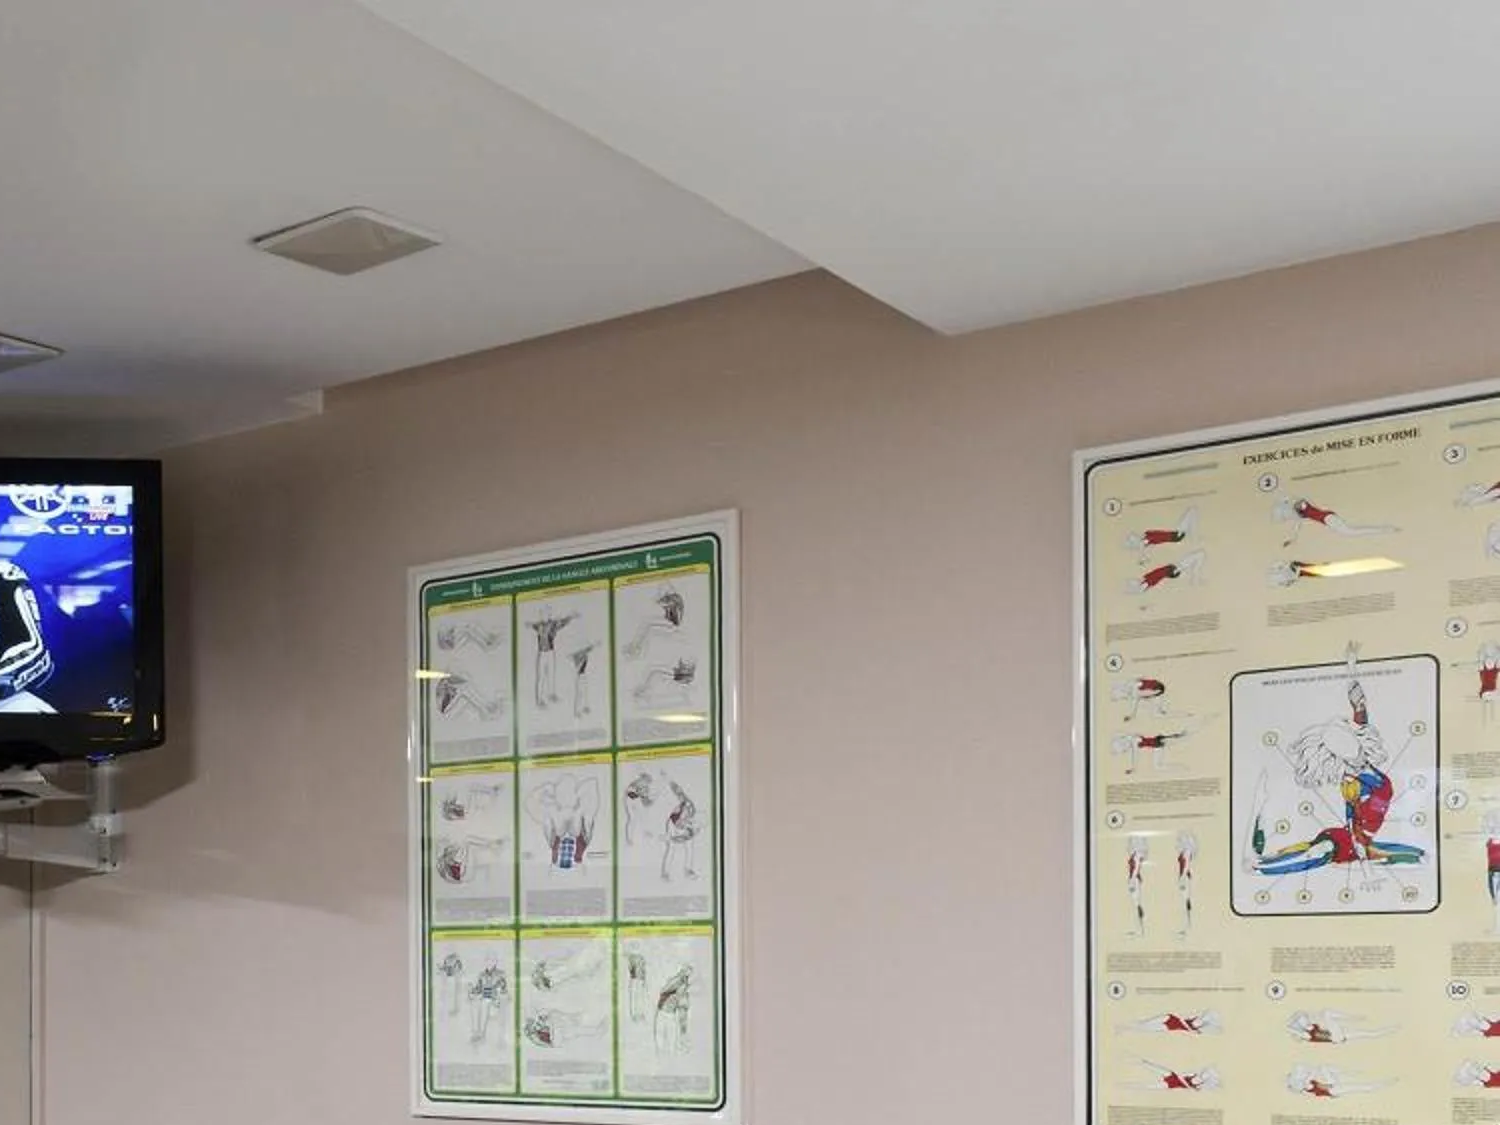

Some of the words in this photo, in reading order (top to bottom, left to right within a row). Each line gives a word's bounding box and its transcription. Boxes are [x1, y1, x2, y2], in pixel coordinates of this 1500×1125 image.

[1243, 447, 1309, 465] EXERCICES
[1325, 437, 1357, 451] MISE
[1359, 434, 1375, 446] EN
[1377, 427, 1421, 443] FORME
